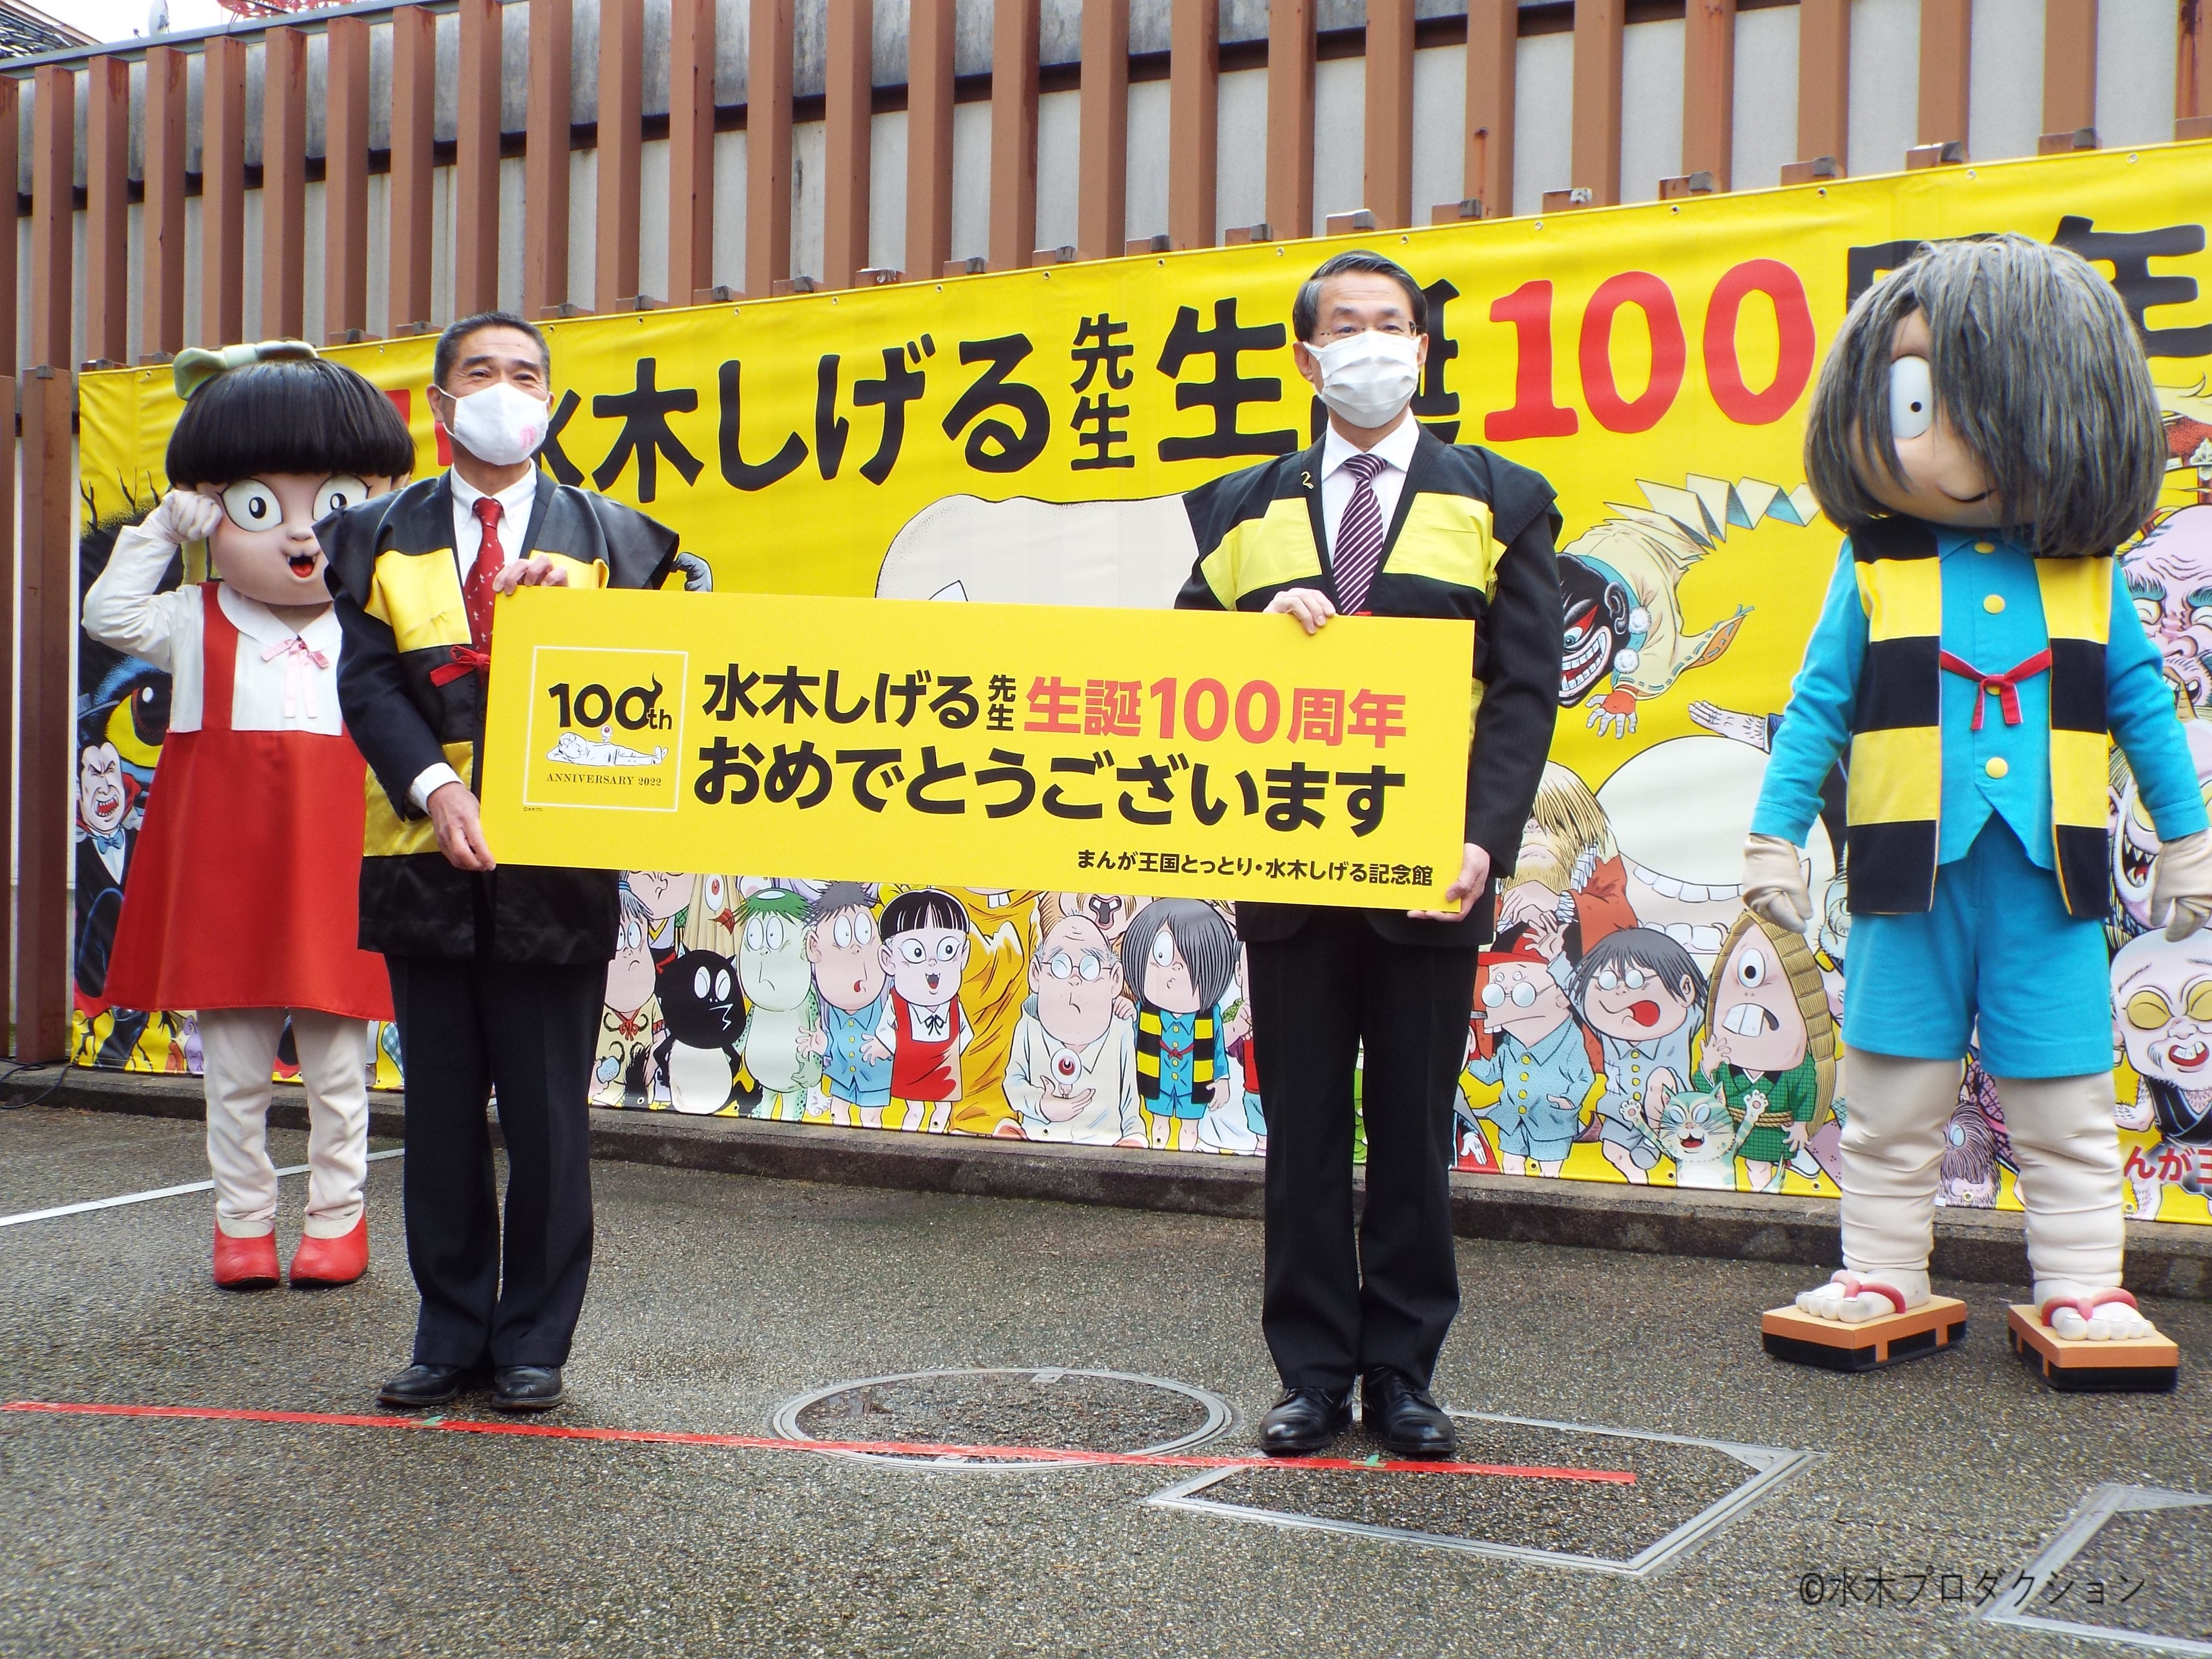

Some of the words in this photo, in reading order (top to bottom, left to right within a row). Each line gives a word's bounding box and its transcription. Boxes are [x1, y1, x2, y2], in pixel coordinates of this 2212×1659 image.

[548, 671, 672, 730] 100th
[546, 773, 635, 785] ANNIVERSARY
[637, 777, 662, 786] 2022
[694, 736, 1406, 838] おめでとうございます
